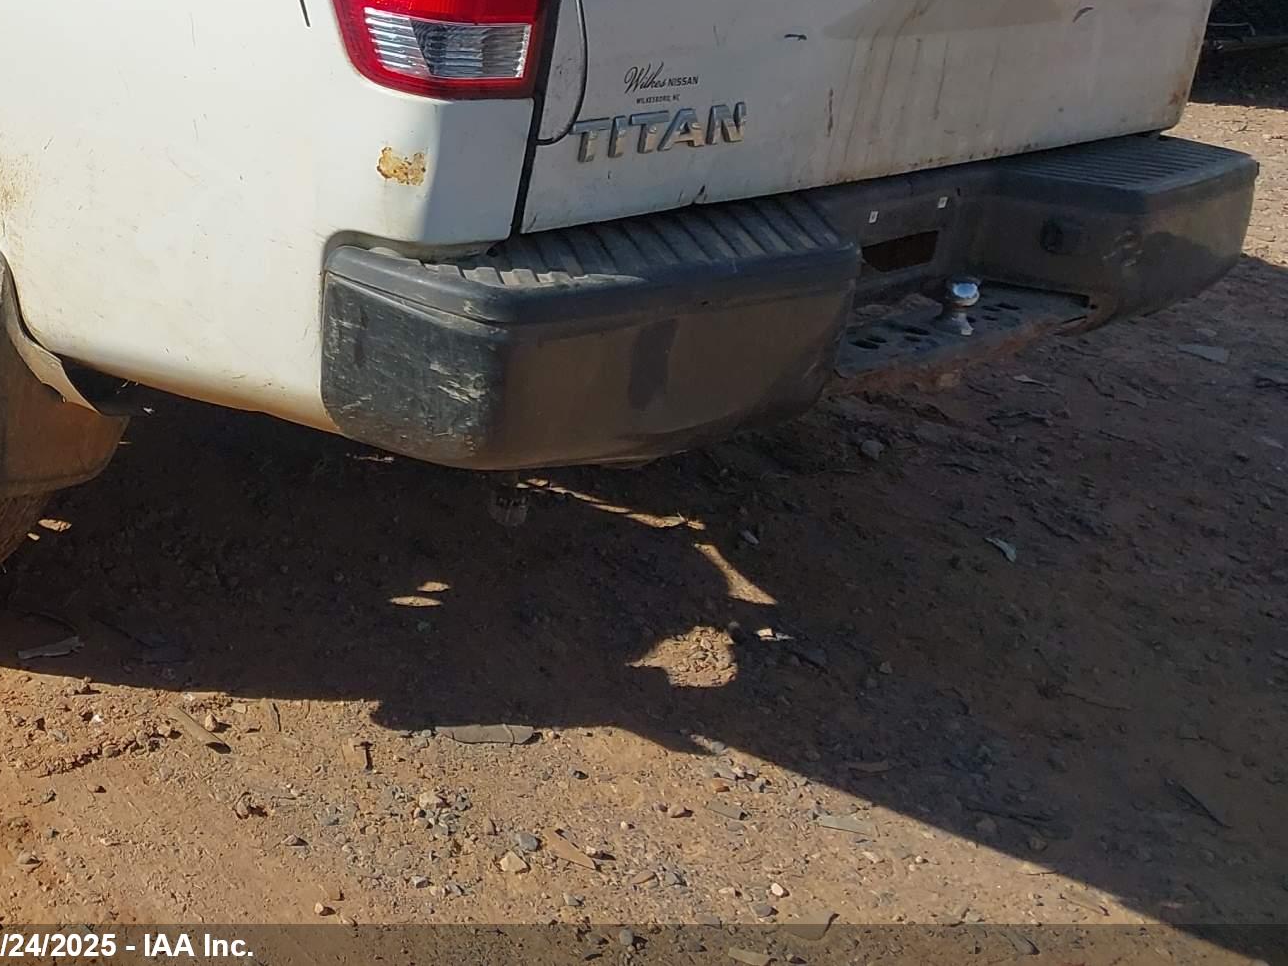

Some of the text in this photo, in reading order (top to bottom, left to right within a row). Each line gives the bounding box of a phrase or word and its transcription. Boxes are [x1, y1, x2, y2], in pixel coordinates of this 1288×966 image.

[624, 61, 700, 94] Wilkes NISSAN
[572, 101, 748, 163] TITAN
